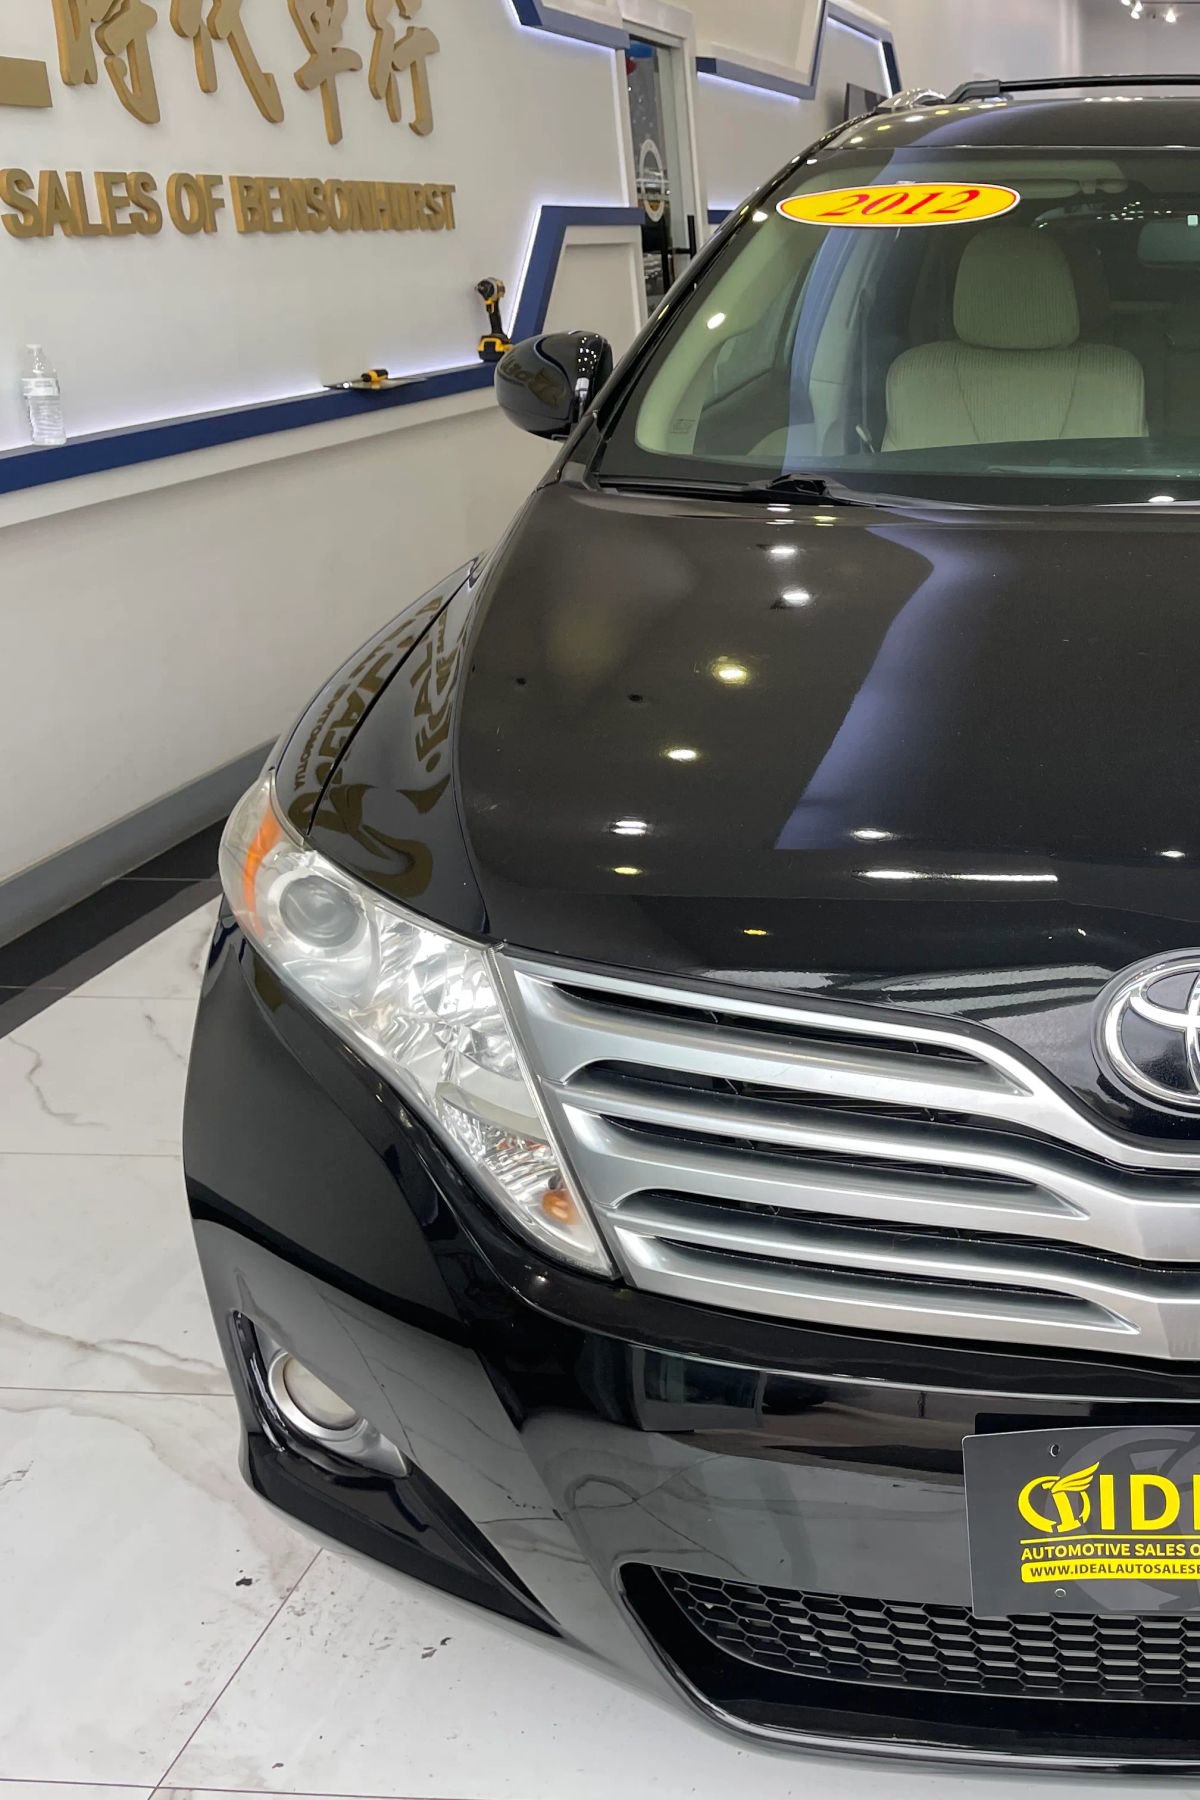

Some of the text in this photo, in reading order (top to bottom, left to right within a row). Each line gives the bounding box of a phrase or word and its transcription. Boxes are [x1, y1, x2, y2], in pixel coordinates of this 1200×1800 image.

[0, 168, 457, 239] SALES OF BENSONHURST
[817, 189, 981, 217] 2012
[1021, 1543, 1131, 1561] AUTOMOTIVE
[1134, 1543, 1186, 1557] SALES
